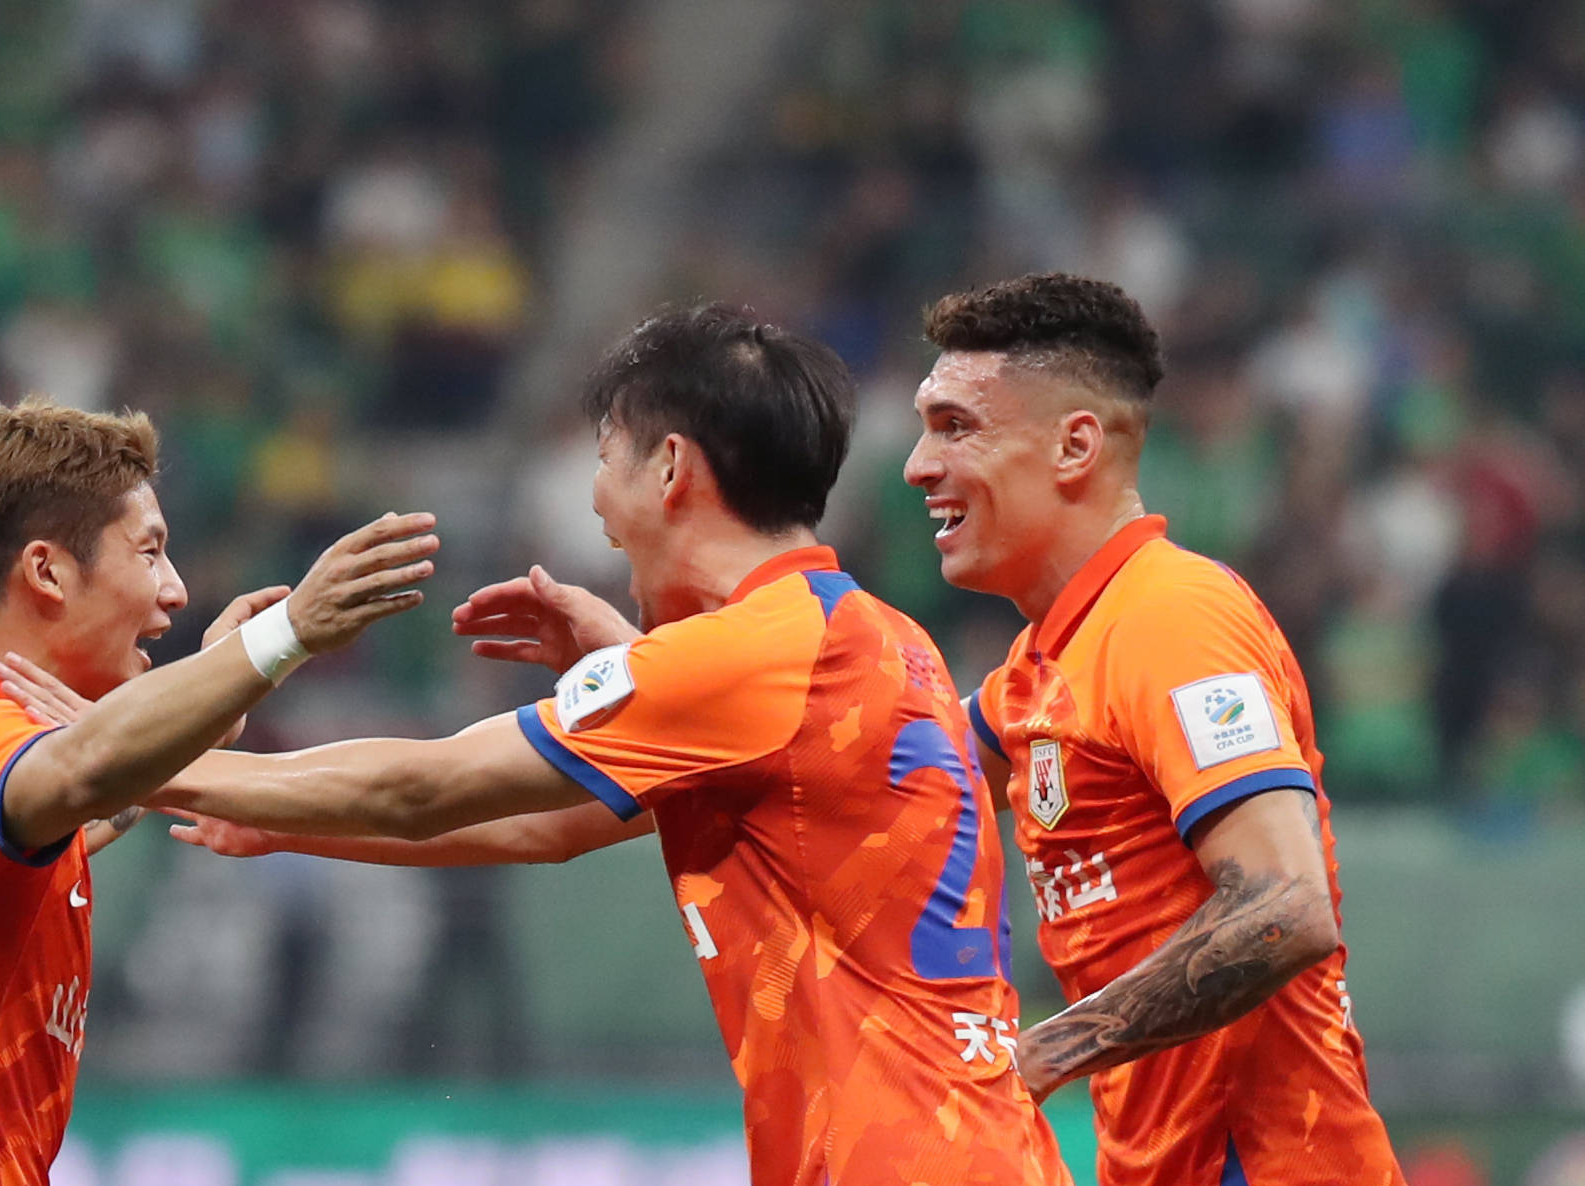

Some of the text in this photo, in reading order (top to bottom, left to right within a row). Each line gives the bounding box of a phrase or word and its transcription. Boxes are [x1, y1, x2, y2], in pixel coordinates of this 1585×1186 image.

[1216, 734, 1254, 751] CFA CUP
[889, 719, 1011, 984] 2
[46, 975, 89, 1061] 山
